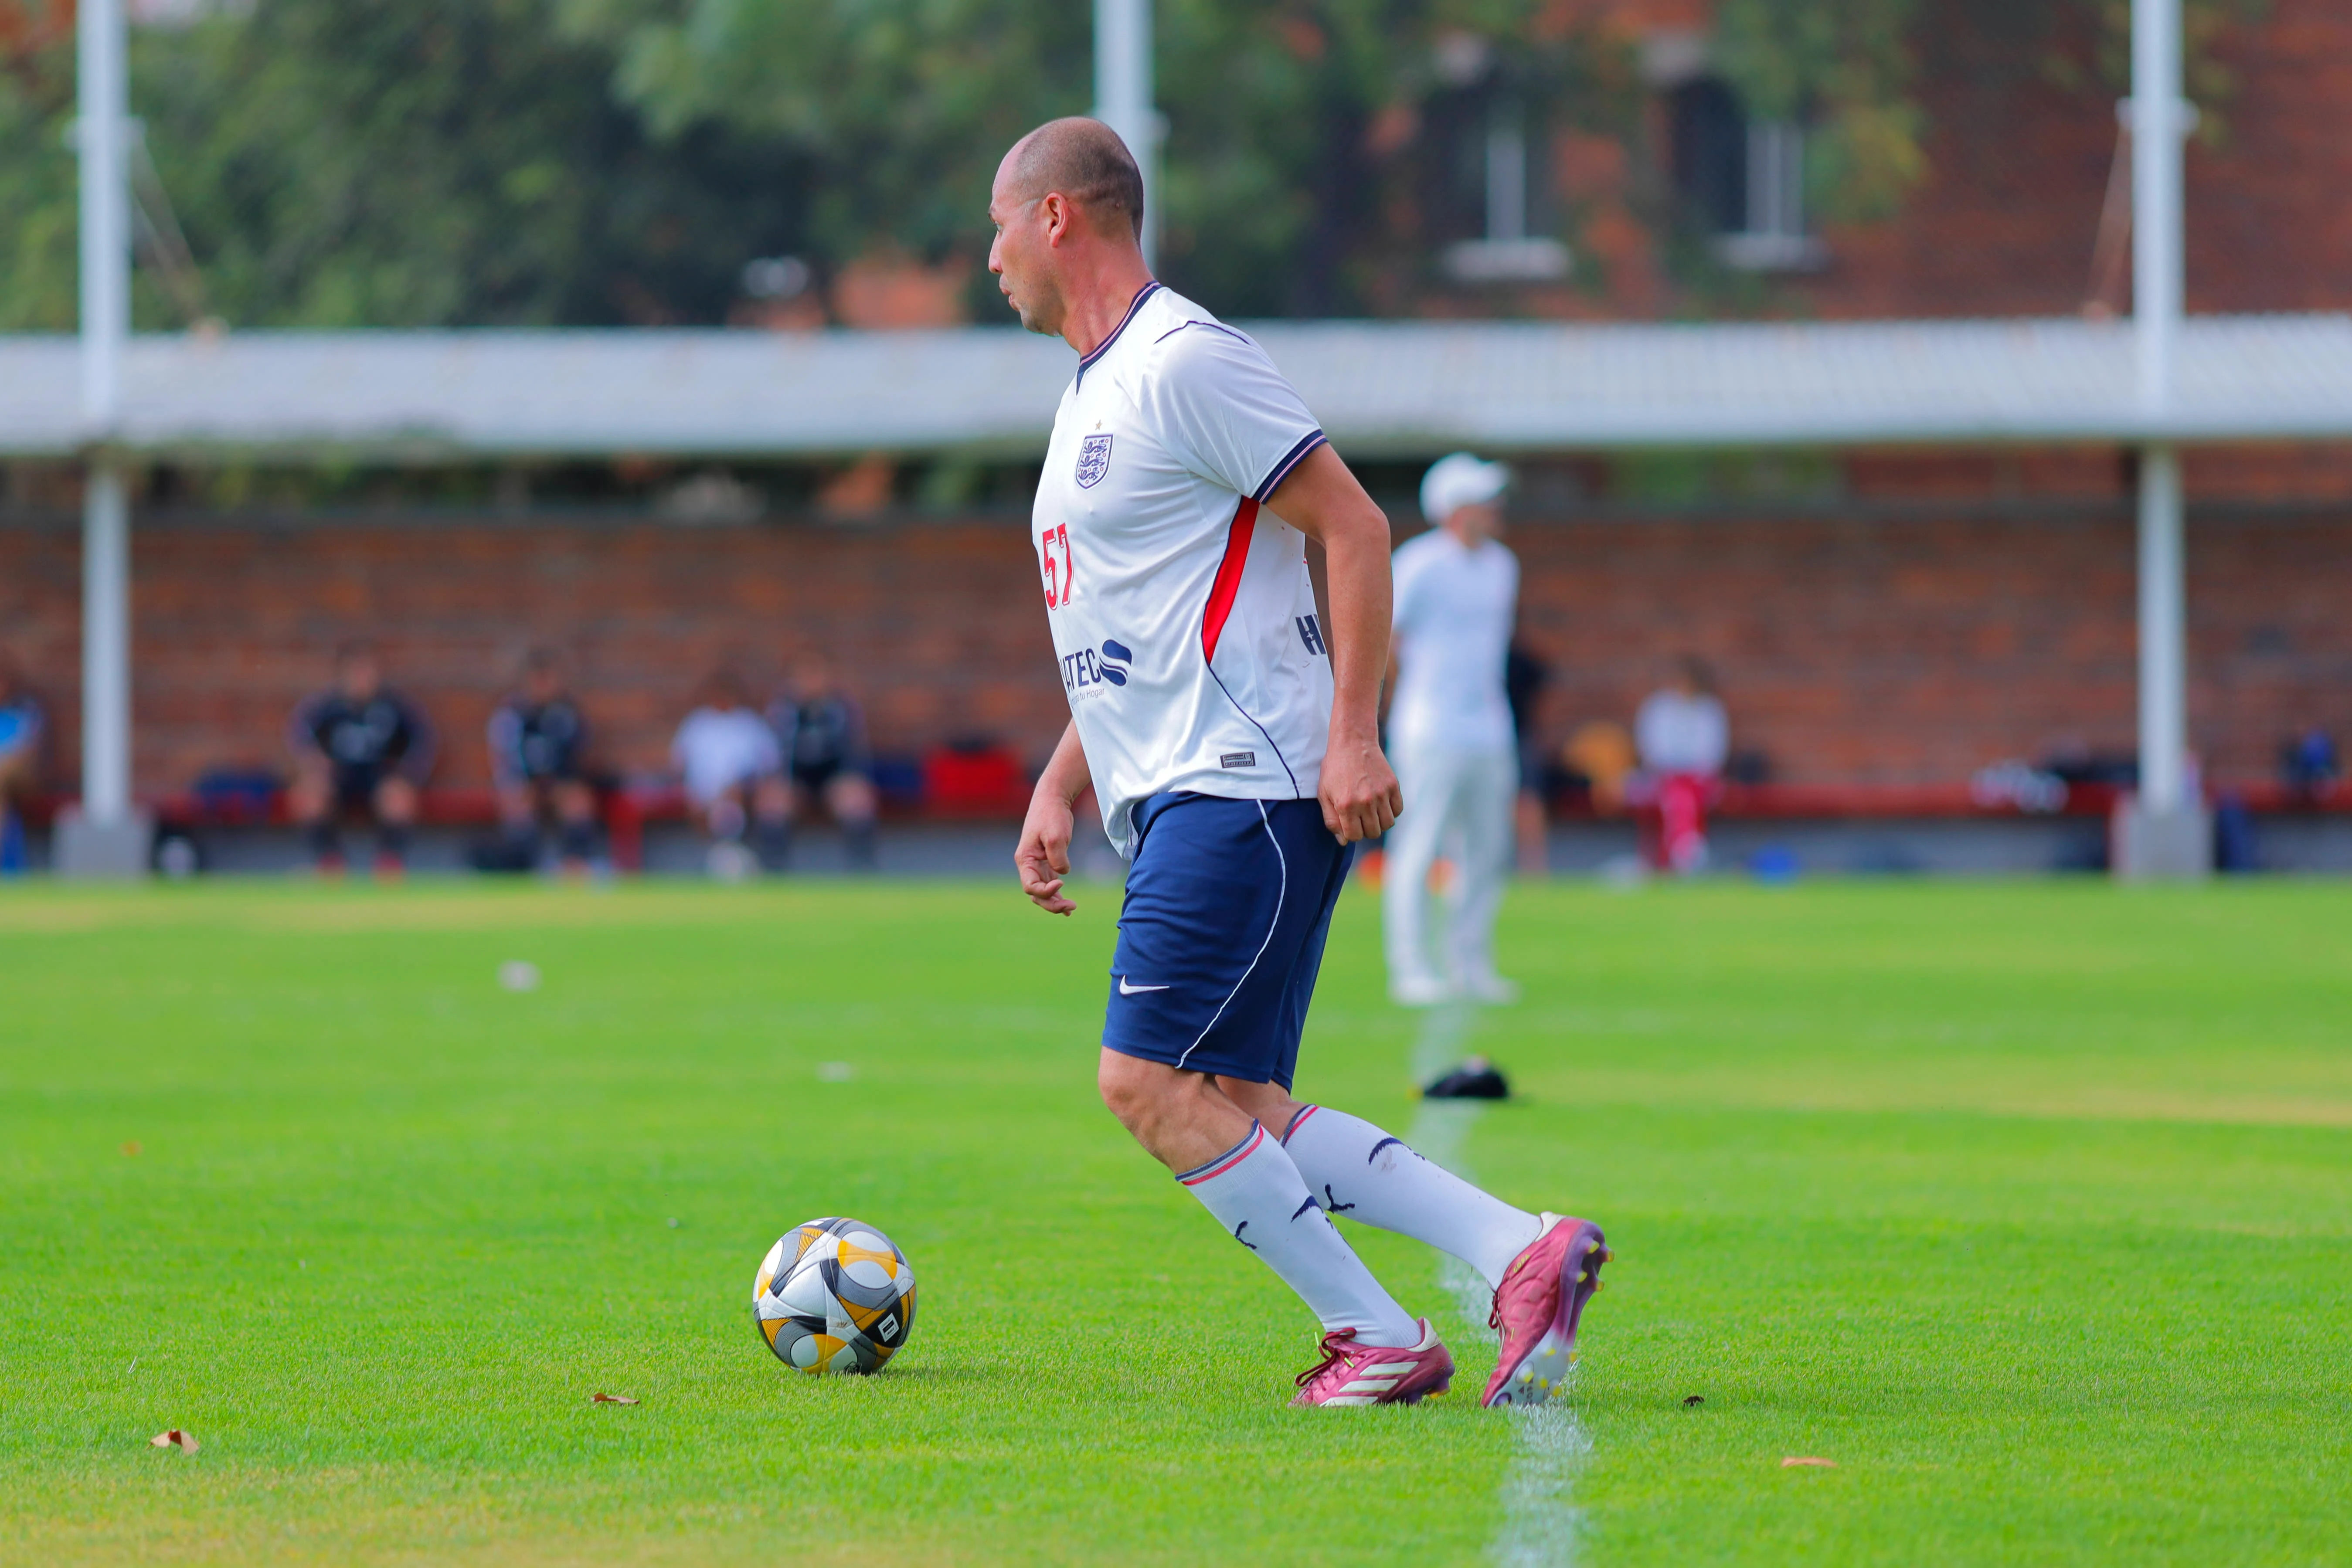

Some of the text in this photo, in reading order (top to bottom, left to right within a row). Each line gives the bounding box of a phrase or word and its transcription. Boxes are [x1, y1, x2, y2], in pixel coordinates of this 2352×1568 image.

[1042, 523, 1074, 611] 57
[1295, 614, 1328, 655] H
[1059, 648, 1101, 693] ATEC
[1086, 688, 1105, 699] Hogar
